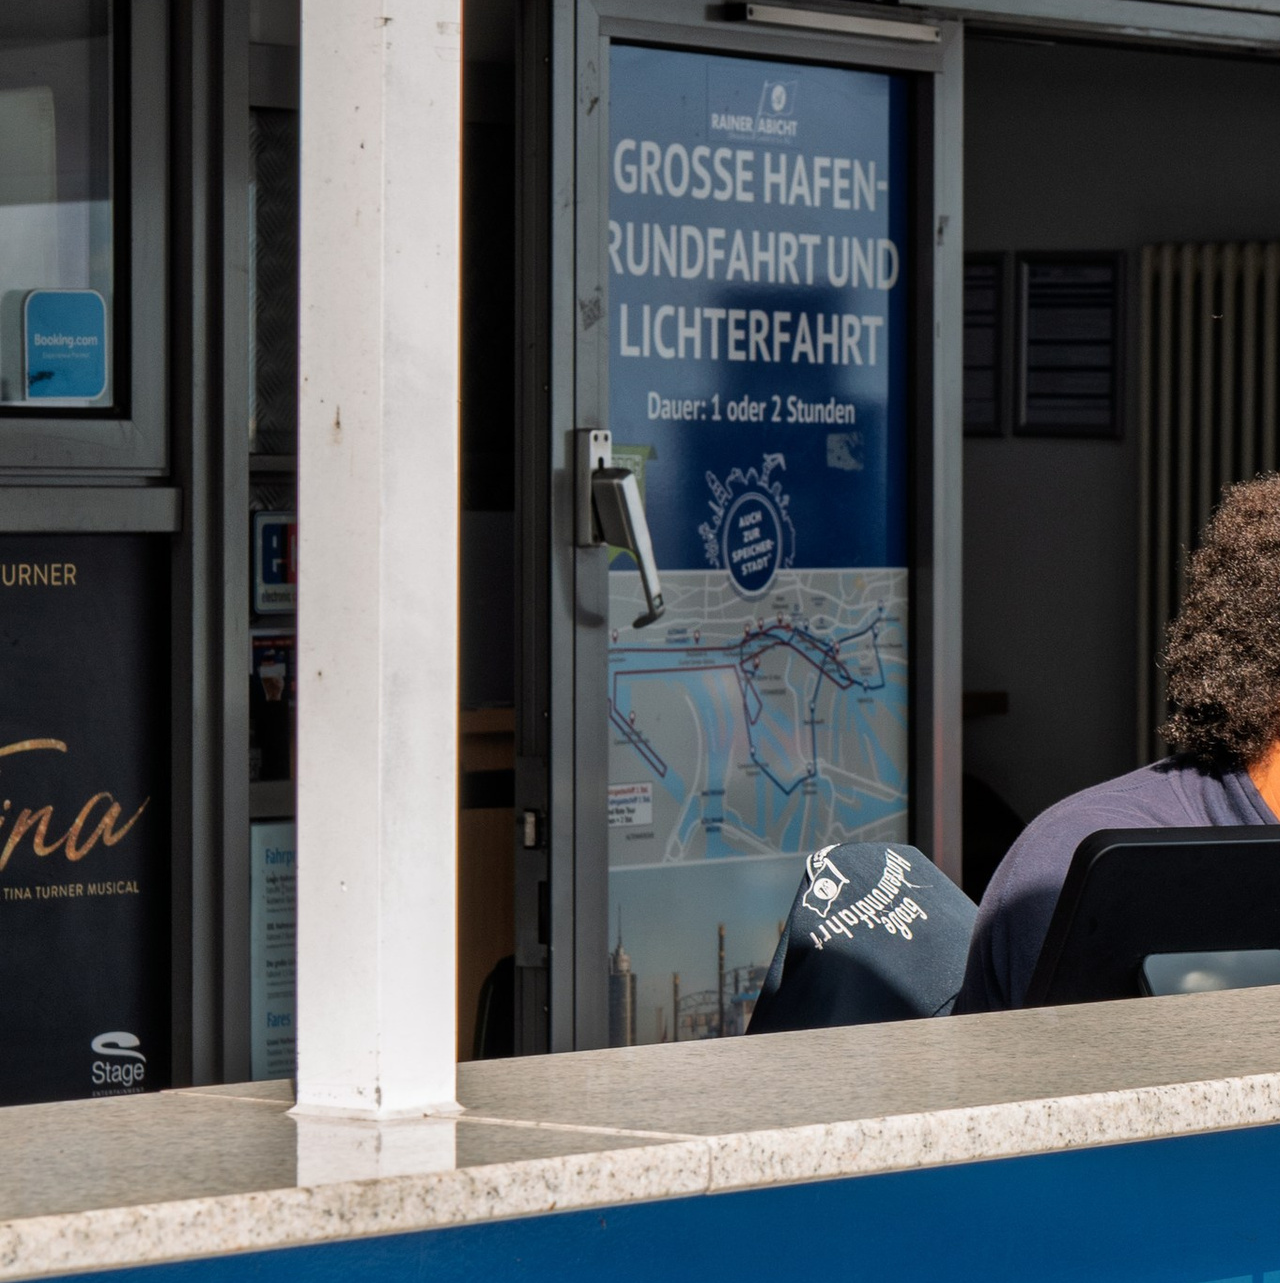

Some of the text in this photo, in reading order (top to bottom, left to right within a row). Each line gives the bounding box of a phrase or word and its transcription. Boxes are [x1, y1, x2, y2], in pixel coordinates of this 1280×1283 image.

[712, 113, 798, 137] RAINER ABICHT
[613, 138, 889, 212] GROSSE HAFEN-
[608, 219, 900, 291] RUNDFAHRT UND
[34, 333, 98, 349] Booking.com
[619, 303, 884, 367] LICHTERFAHRT
[648, 391, 856, 425] Dauer: 1 oder 2 Stunden
[0, 563, 77, 587] URNER
[3, 880, 140, 901] TINA TURNER MUSICAL
[91, 1061, 145, 1087] Stage
